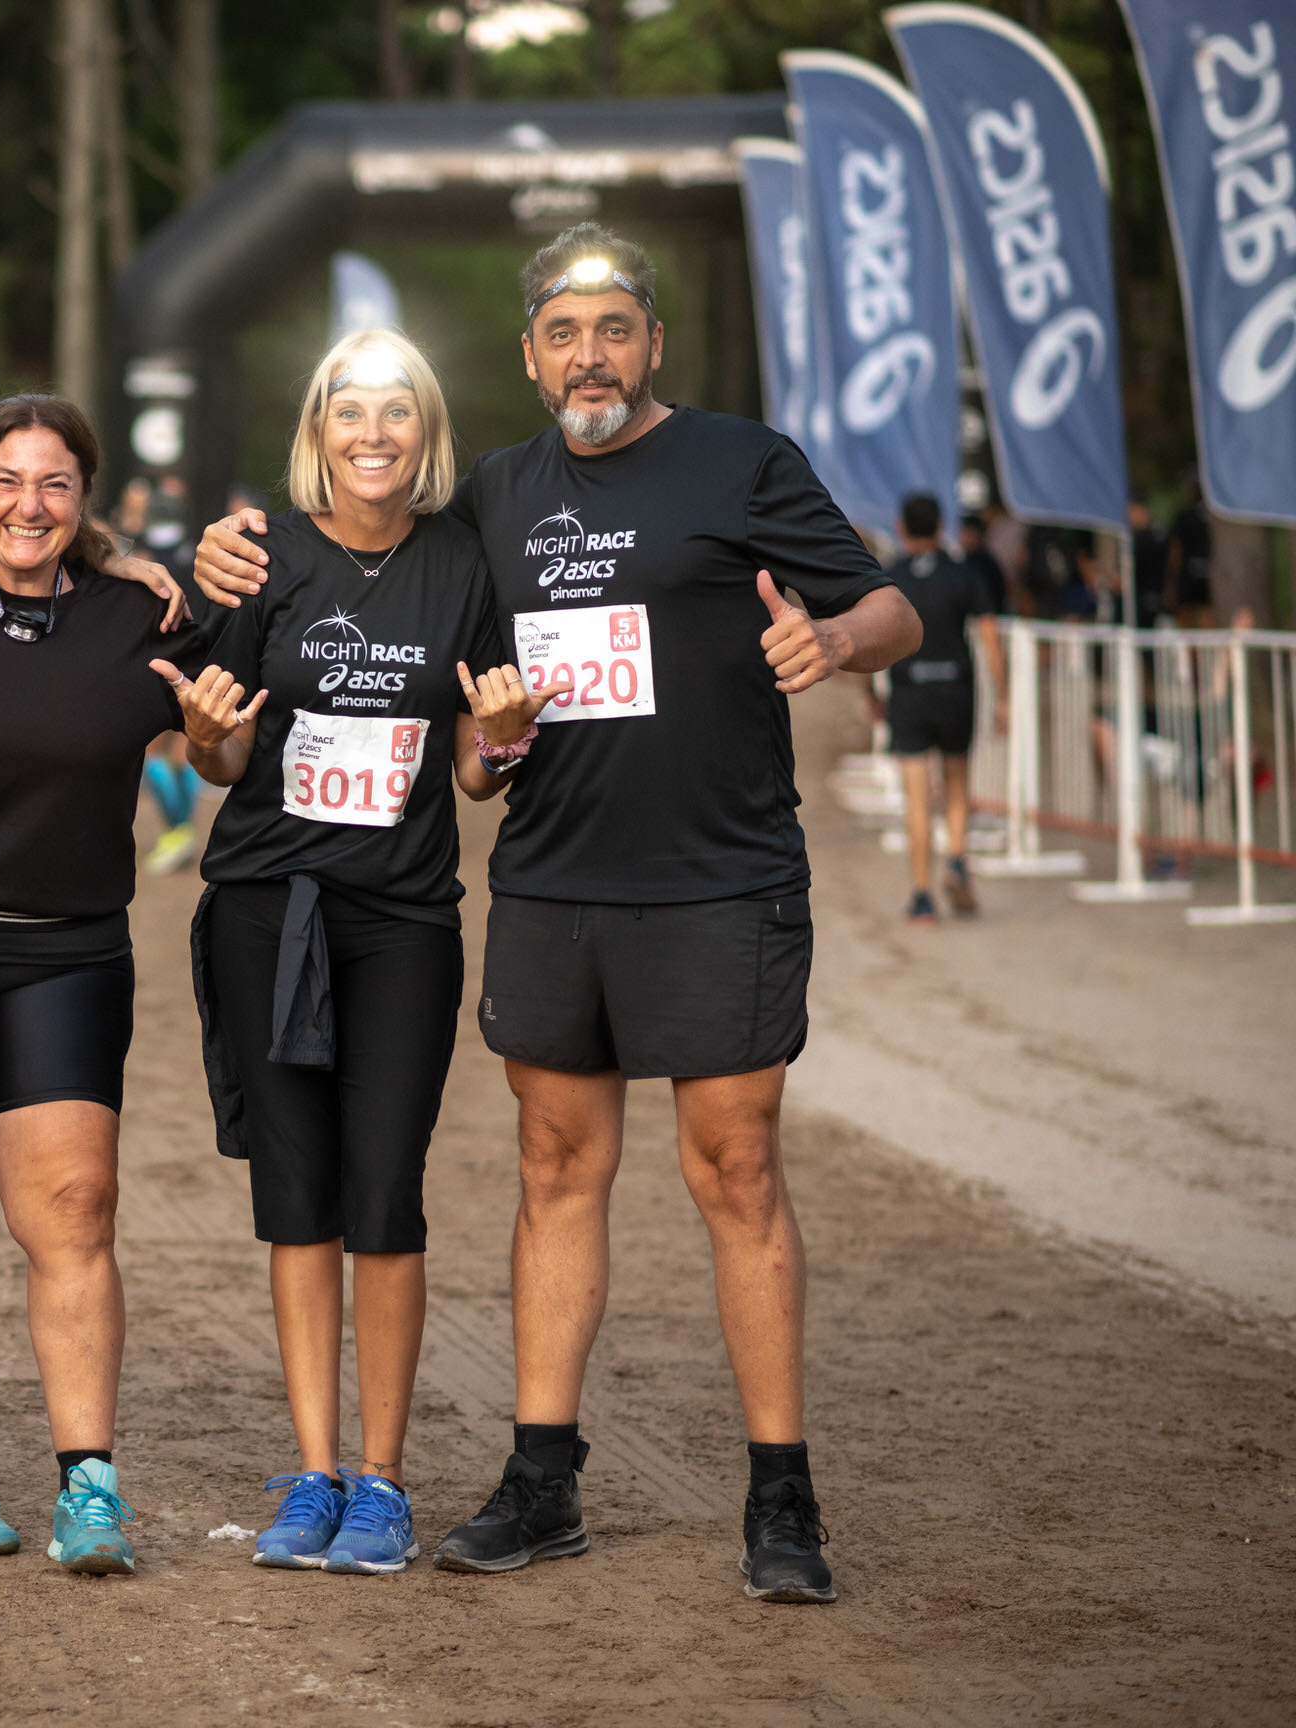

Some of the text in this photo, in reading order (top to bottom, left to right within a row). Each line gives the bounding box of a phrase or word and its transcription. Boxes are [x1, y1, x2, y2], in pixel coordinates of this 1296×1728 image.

[525, 530, 636, 556] NIGHT RACE
[564, 559, 616, 580] asics
[550, 586, 603, 602] pinamar
[618, 617, 630, 633] 5
[518, 632, 560, 643] NIGHT RACE
[613, 634, 637, 647] KM
[301, 641, 426, 664] NIGHT RACE
[347, 671, 407, 691] asics
[527, 658, 638, 707] 3020
[332, 694, 391, 708] pinamar
[312, 735, 334, 745] RACE
[402, 730, 412, 745] 5
[394, 746, 415, 758] KM
[294, 763, 411, 813] 3019
